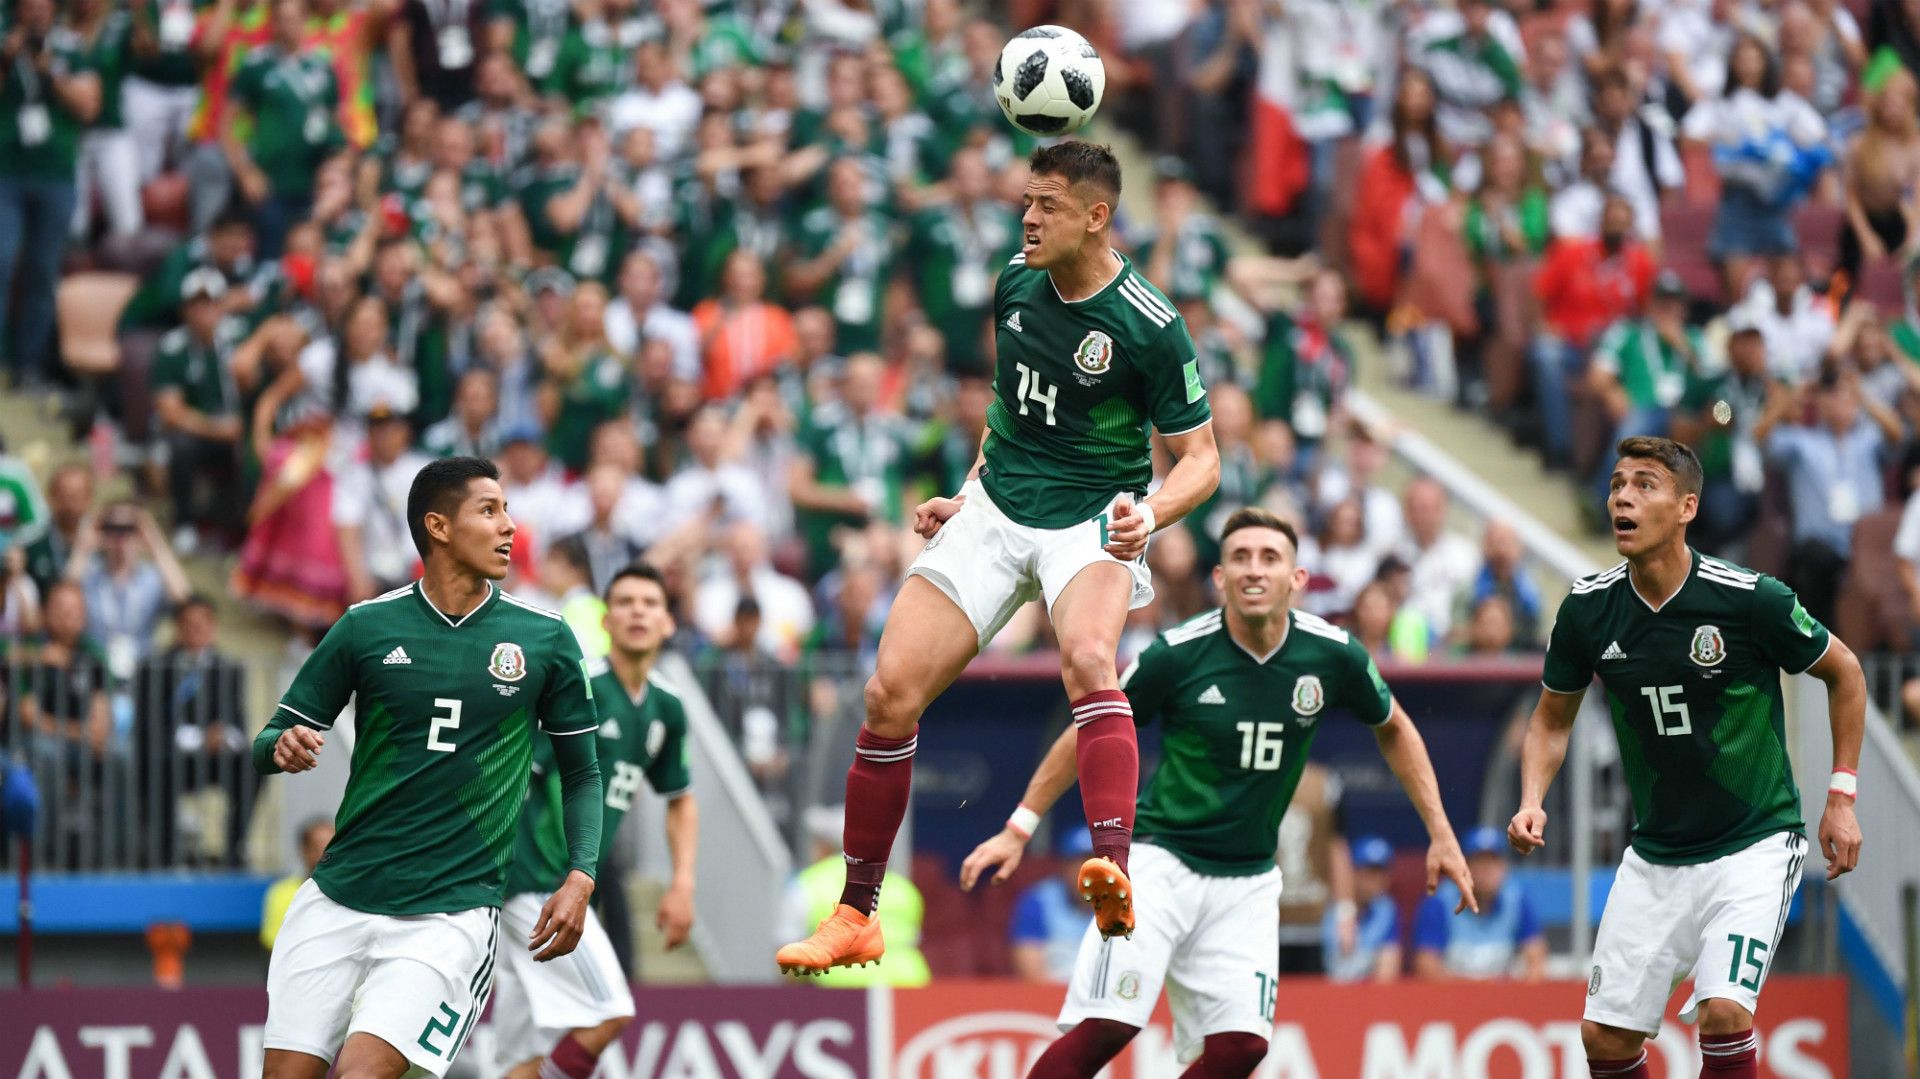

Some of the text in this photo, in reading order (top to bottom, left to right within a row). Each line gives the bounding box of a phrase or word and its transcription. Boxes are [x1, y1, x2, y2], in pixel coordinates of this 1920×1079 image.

[1016, 361, 1058, 426] 14
[1091, 513, 1120, 550] 1
[427, 697, 462, 753] 2
[1640, 684, 1692, 736] 15
[1236, 721, 1284, 770] 16
[605, 760, 644, 812] 22
[1728, 933, 1768, 993] 15
[417, 1000, 461, 1057] 2
[1360, 1018, 1835, 1079] MOTS
